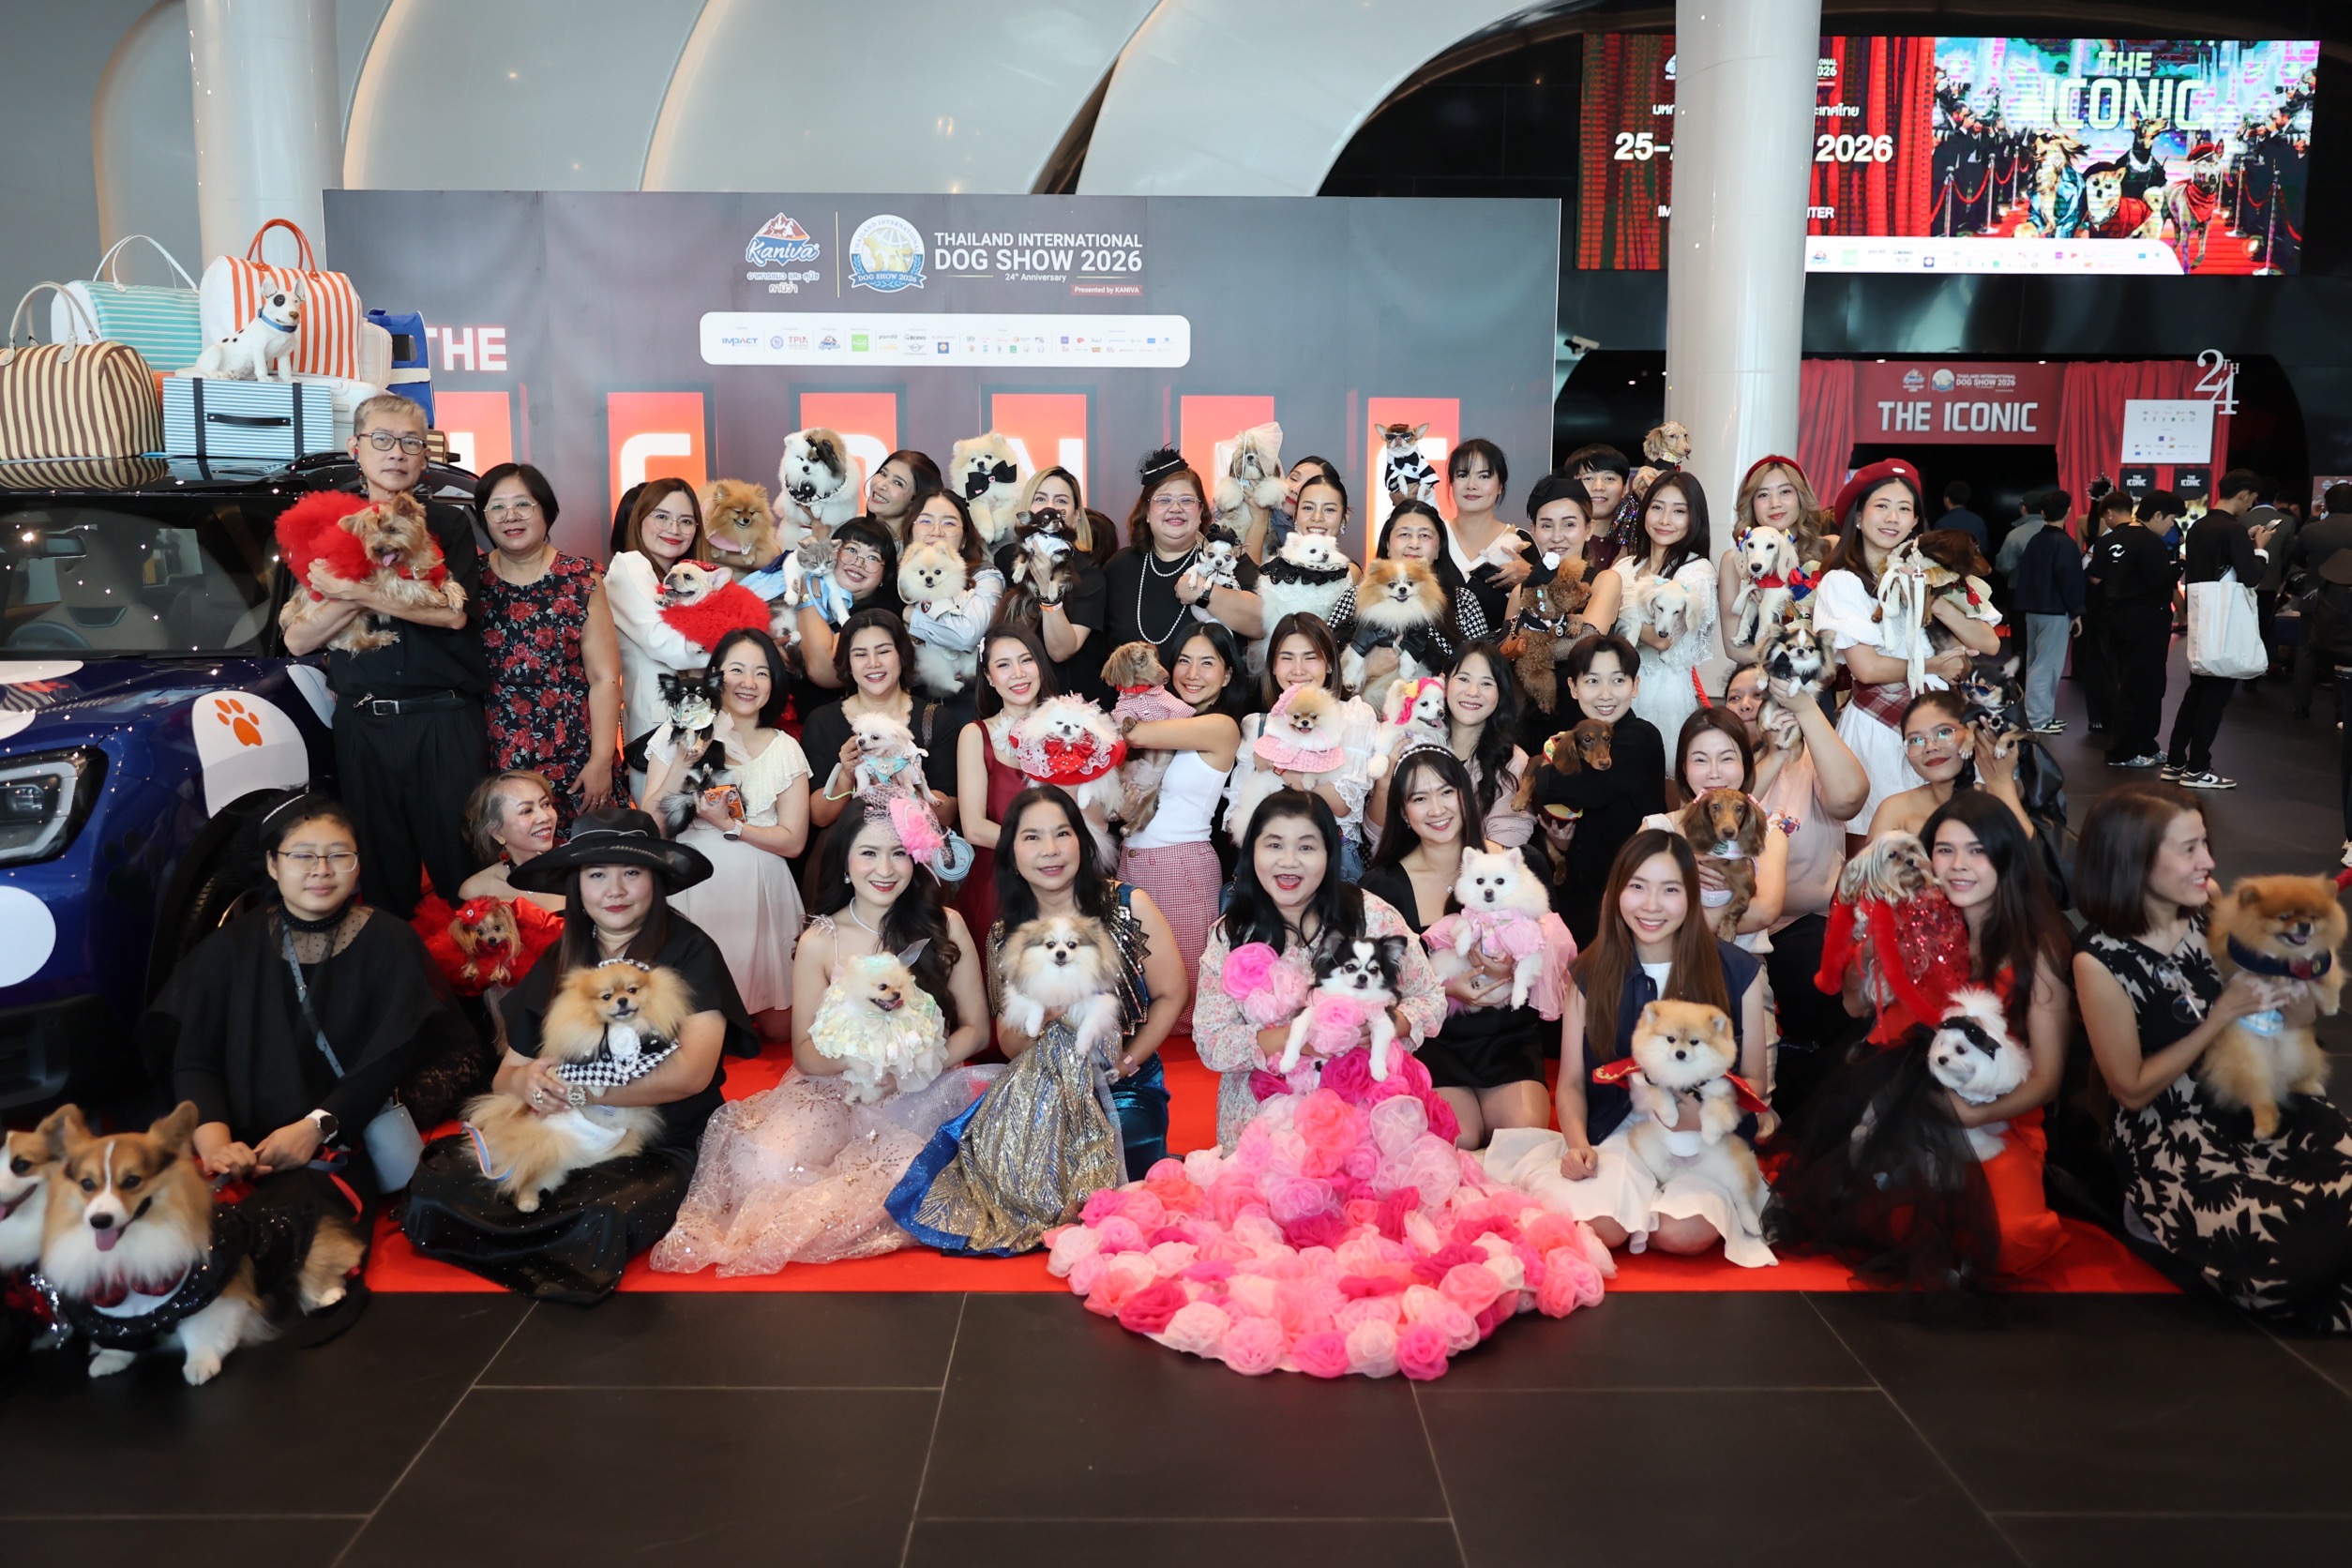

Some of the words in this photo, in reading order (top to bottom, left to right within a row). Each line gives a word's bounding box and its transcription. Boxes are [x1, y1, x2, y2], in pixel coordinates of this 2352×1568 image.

[1817, 66, 1838, 77] 026
[2099, 52, 2152, 77] THE
[2043, 78, 2205, 130] ICONIC
[1613, 132, 1673, 160] 25-
[1815, 134, 1893, 163] 2026
[1807, 206, 1834, 219] TER
[853, 221, 877, 252] THAILAND
[878, 219, 921, 252] INTERNATIONAL
[934, 233, 1014, 247] THAILAND
[1018, 234, 1143, 248] INTERNATIONAL
[748, 240, 817, 265] Kaniva
[934, 249, 988, 271] DOG
[995, 249, 1074, 271] SHOW
[1080, 249, 1142, 272] 2026
[858, 273, 874, 281] DOG
[876, 272, 897, 280] SHOW
[898, 273, 917, 282] 2026
[1004, 272, 1019, 281] 24th
[1020, 273, 1067, 283] Anniversary
[1107, 286, 1114, 294] by
[722, 338, 759, 346] IMPACT
[1956, 378, 1972, 386] DOG
[1974, 378, 1996, 386] SHOW
[1877, 401, 1932, 431] THE
[1943, 401, 2039, 432] ICONIC
